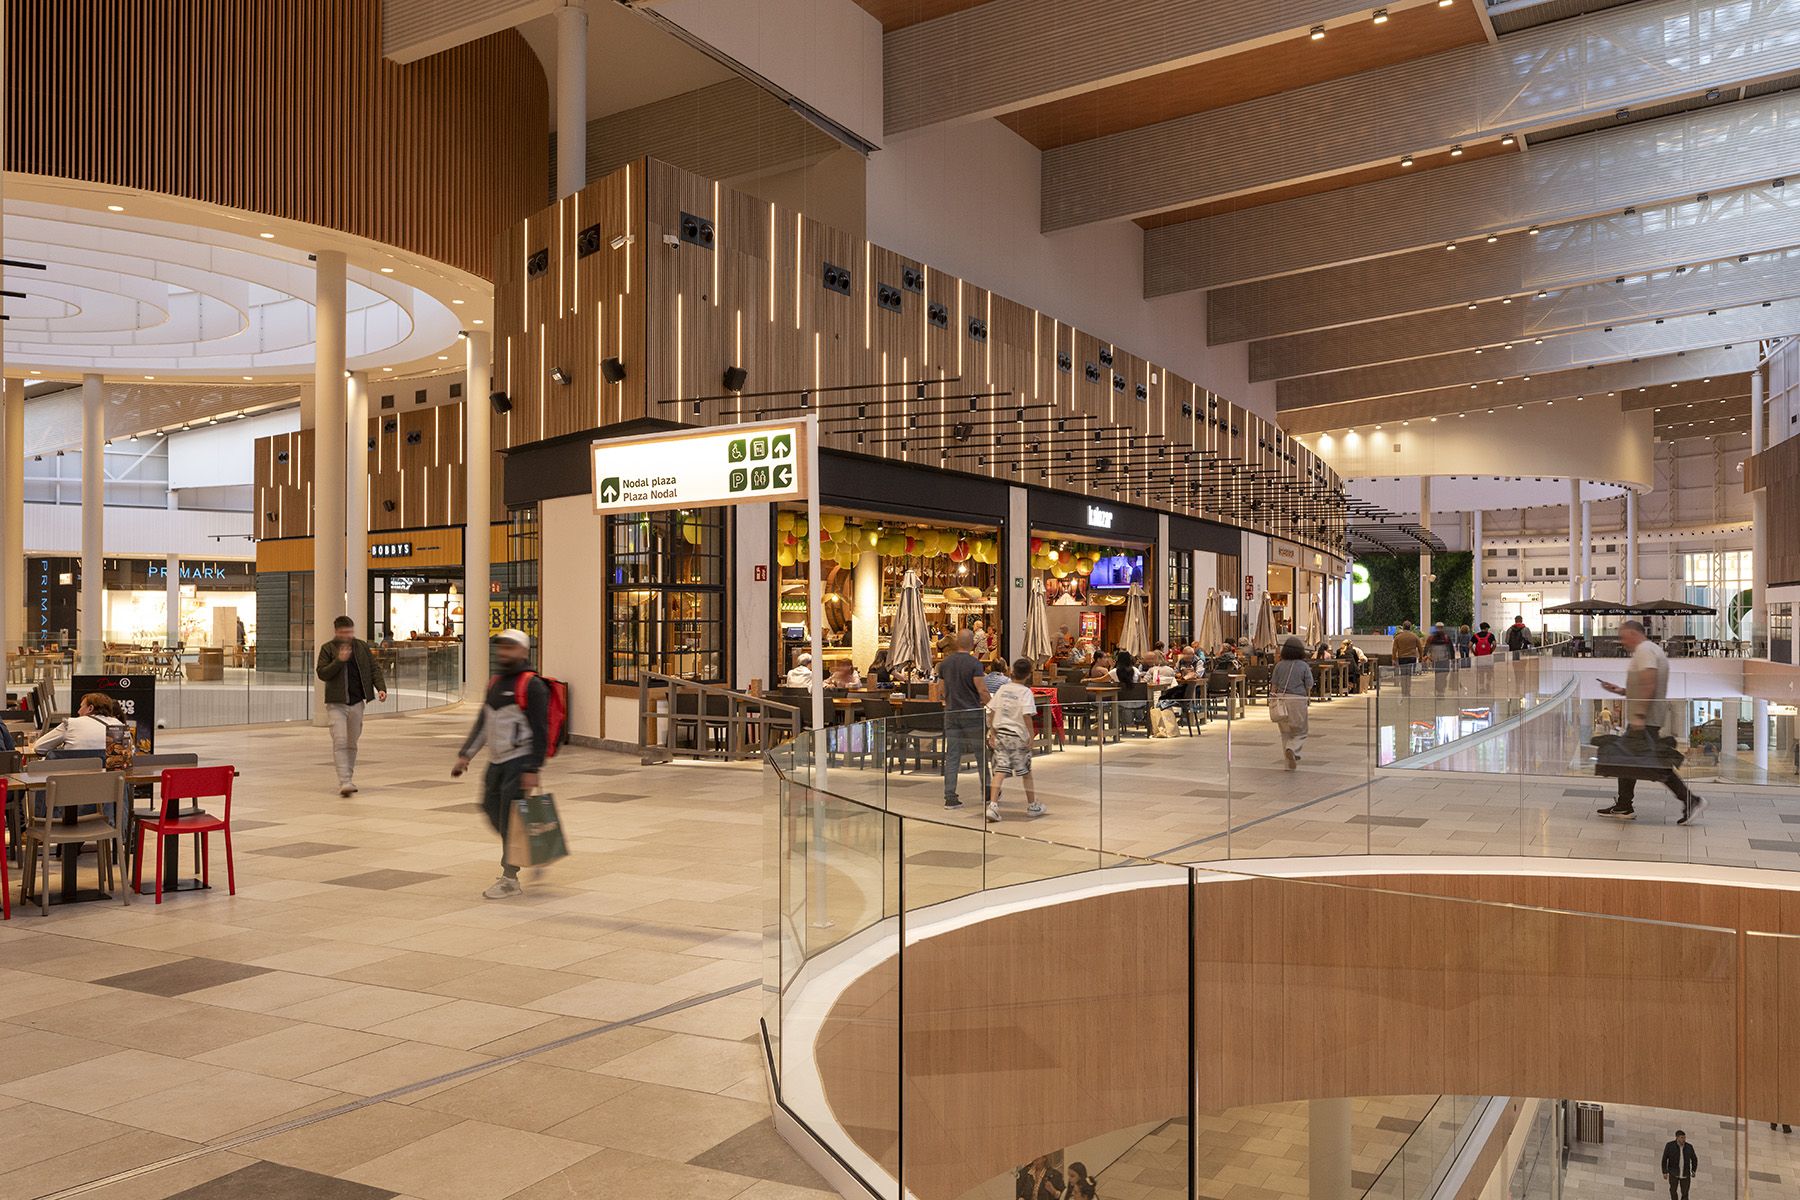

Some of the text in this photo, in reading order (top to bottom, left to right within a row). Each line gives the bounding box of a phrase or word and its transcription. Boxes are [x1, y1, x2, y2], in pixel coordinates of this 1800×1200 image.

[622, 476, 677, 489] Nodal plaza
[623, 488, 677, 502] Plaza Nodal
[371, 543, 409, 556] BOBBYS
[148, 566, 226, 580] PRMARK
